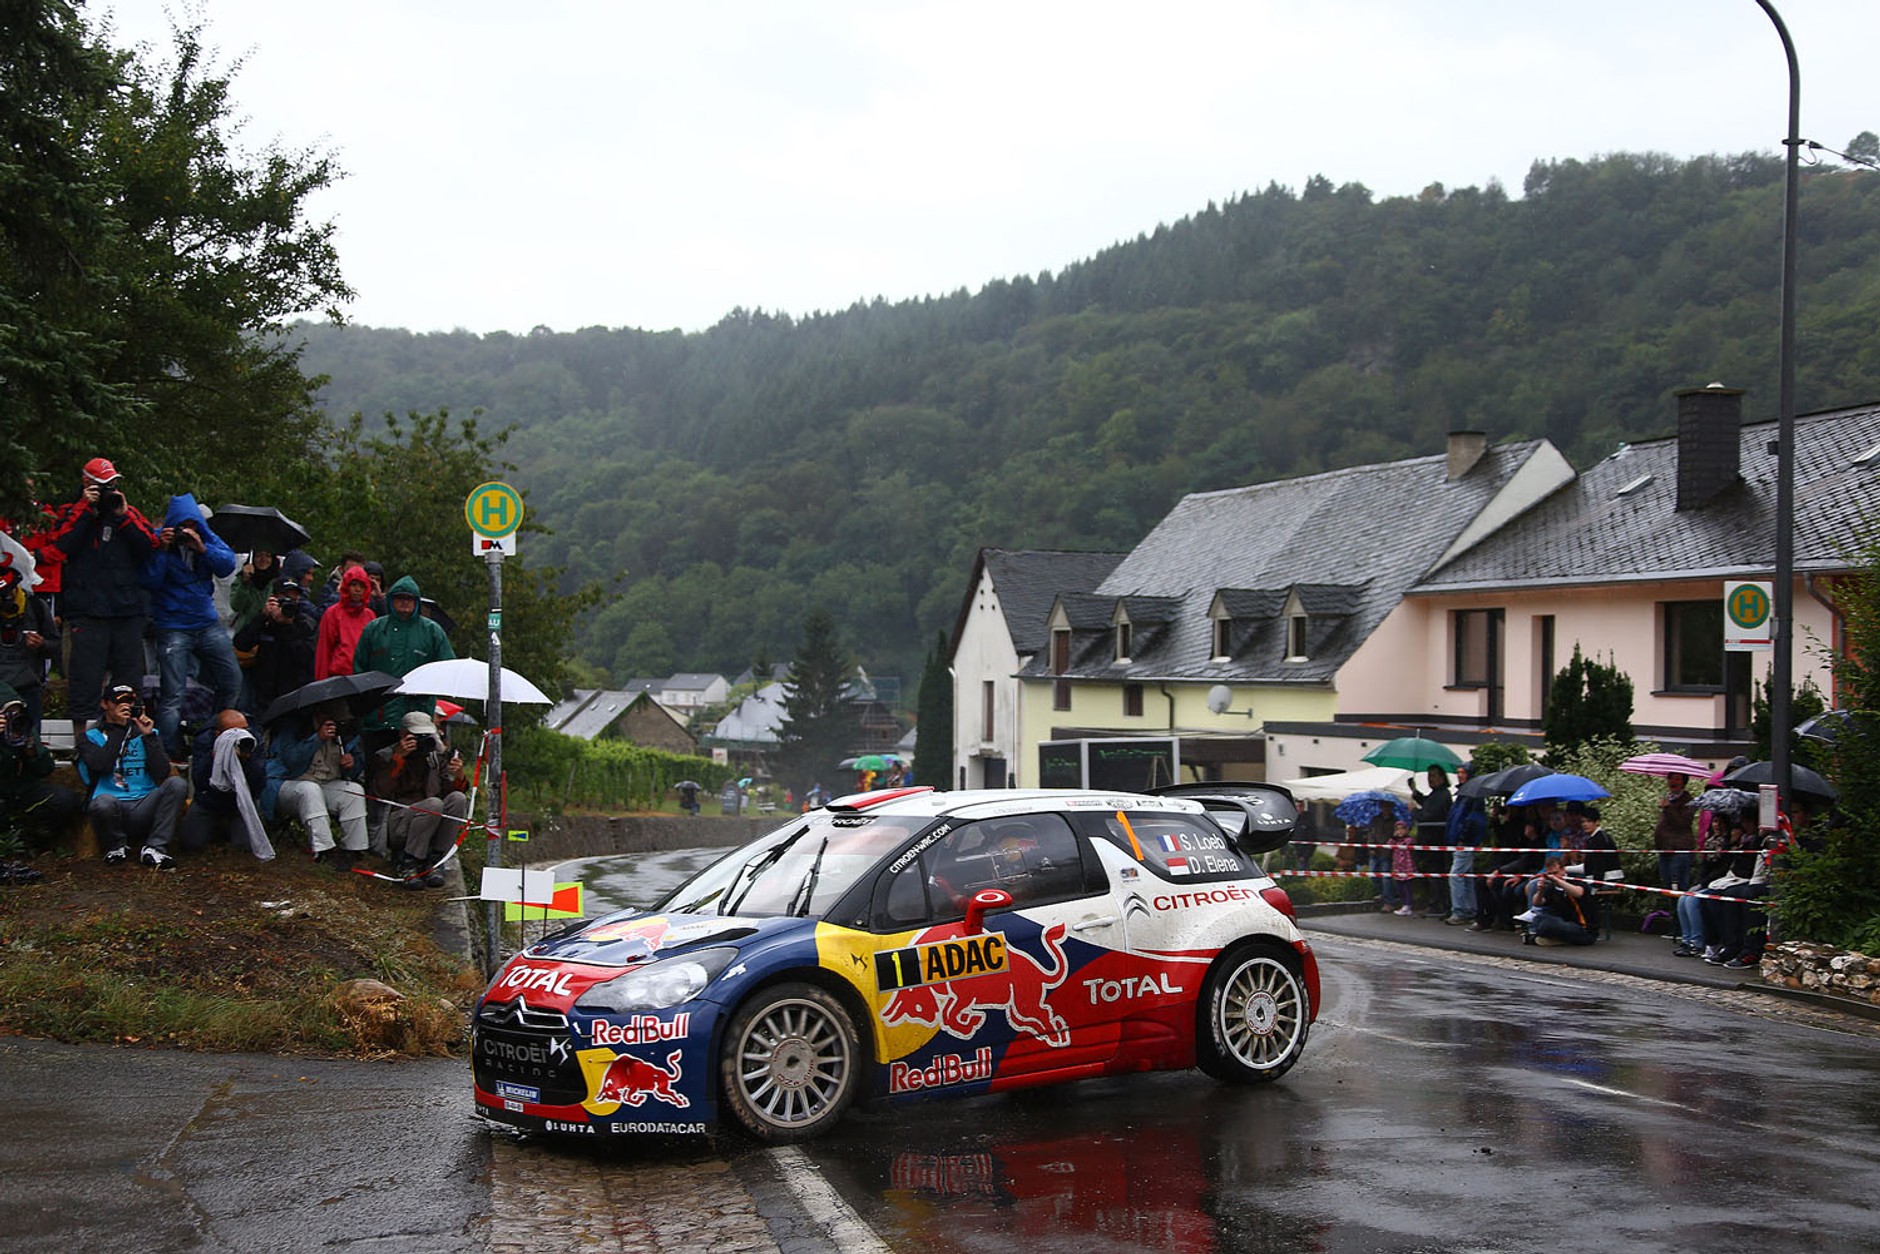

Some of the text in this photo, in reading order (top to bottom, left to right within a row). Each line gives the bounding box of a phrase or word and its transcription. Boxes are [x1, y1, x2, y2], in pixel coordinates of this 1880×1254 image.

[482, 496, 507, 525] H
[1739, 594, 1758, 618] H
[889, 823, 952, 874] CITROEN-WRC.COM
[1179, 833, 1226, 851] S. Loeb
[1188, 855, 1240, 875] D. Elena
[891, 936, 1004, 987] 1 ADAC
[500, 964, 574, 997] TOTAL
[1082, 972, 1183, 1005] TOTAL
[553, 1122, 595, 1134] LUHTA
[611, 1122, 706, 1134] EURODATACAR
